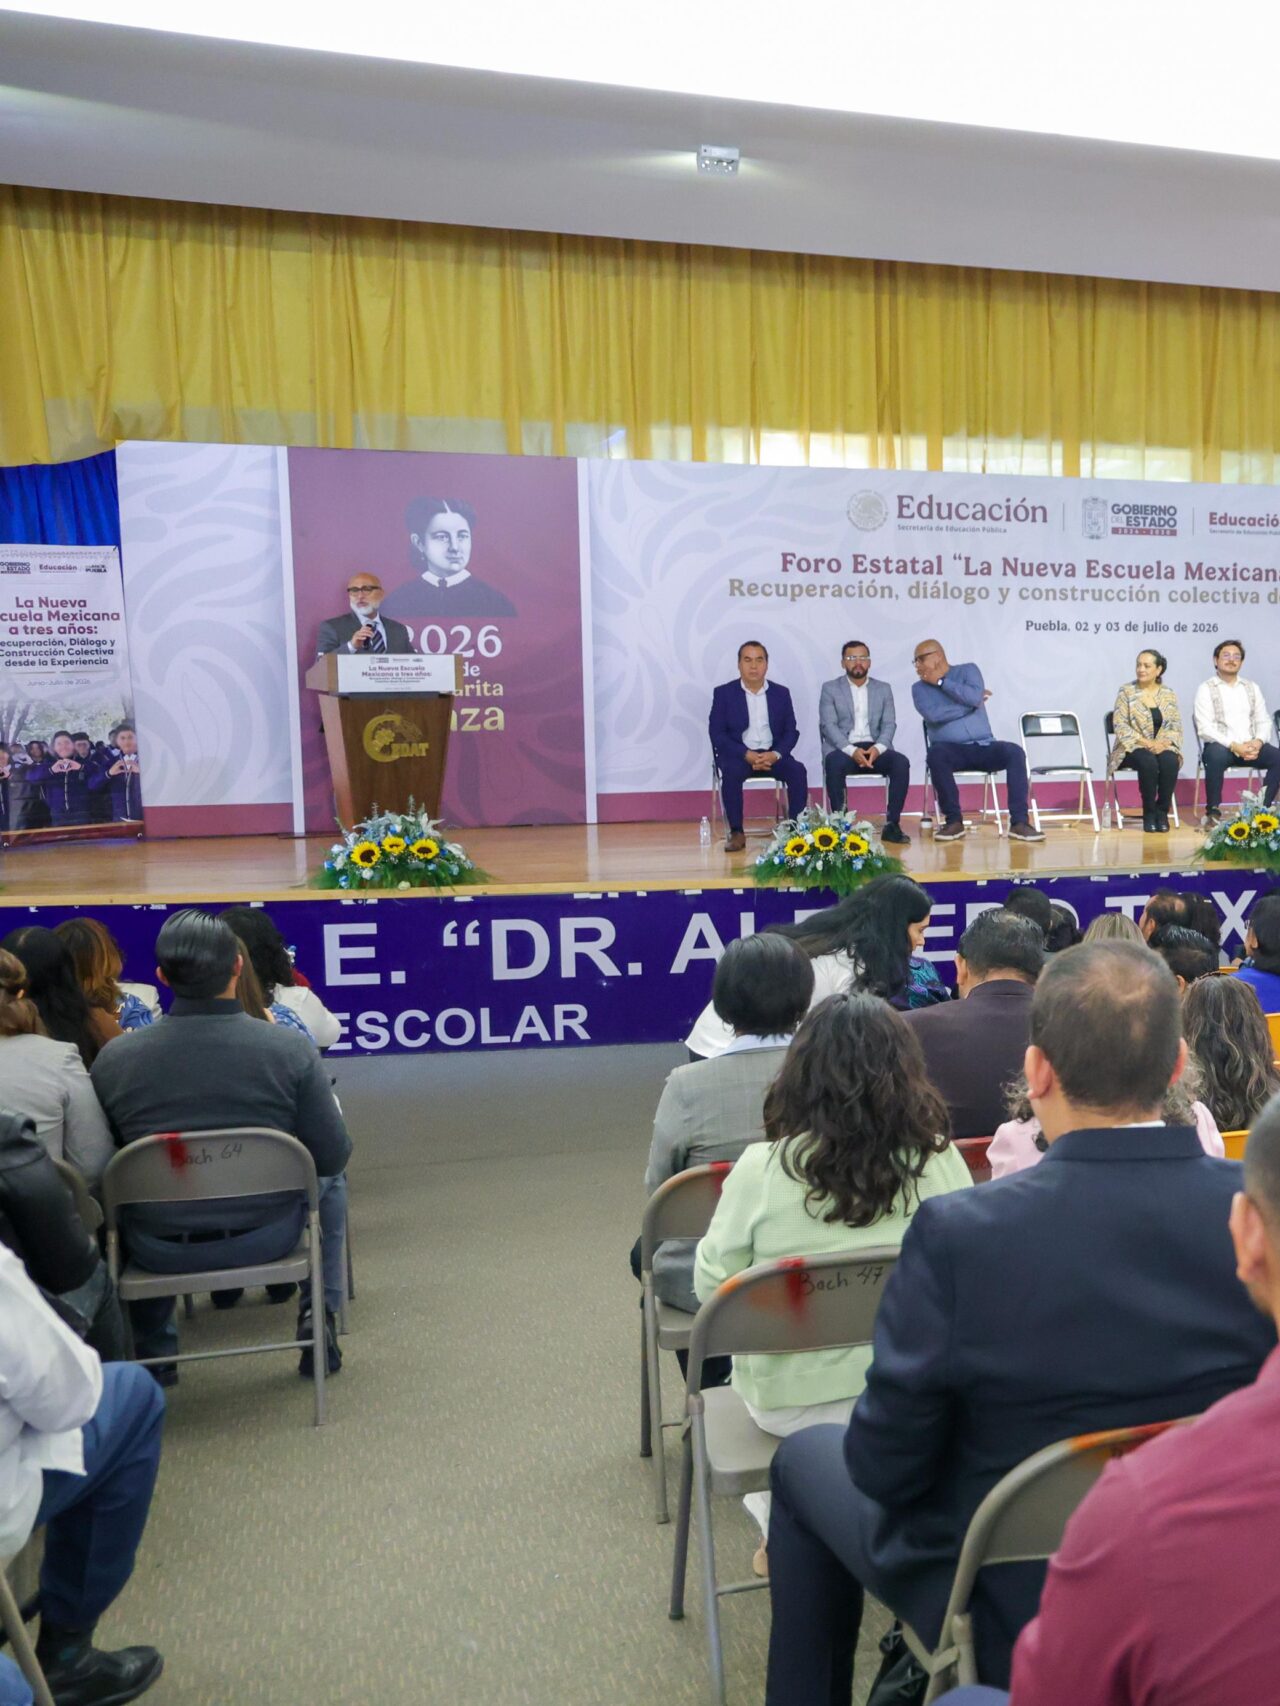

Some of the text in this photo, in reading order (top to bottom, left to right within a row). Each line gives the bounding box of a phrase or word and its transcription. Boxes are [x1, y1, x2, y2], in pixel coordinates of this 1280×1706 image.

[896, 494, 1048, 523] Educación
[1111, 503, 1177, 516] GOBIERNO
[1126, 516, 1177, 528] ESTADO
[946, 525, 980, 533] Educación
[39, 563, 77, 571] Educación
[781, 552, 842, 573] Foro
[852, 554, 943, 575] Estatal
[953, 553, 992, 576] “La
[1001, 556, 1077, 578] Nueva
[1085, 559, 1175, 580] Escuela
[728, 578, 899, 602] Recuperación,
[907, 579, 990, 604] diálogo
[997, 586, 1010, 605] y
[1018, 583, 1160, 604] construcción
[1168, 586, 1259, 605] colectiva
[15, 596, 87, 608] La Nueva
[48, 610, 120, 621] Mexicana
[9, 623, 98, 635] a tres años:
[1025, 620, 1219, 634] Puebla, 02 y 03 de julio de 2026
[69, 638, 107, 648] Diálogo
[110, 639, 116, 647] y
[0, 647, 114, 657] Construcción Colectiva
[5, 657, 109, 667] desde la Experiencia
[323, 922, 407, 987] E.
[441, 915, 643, 981] “DR.
[798, 1266, 884, 1296] Bach 47
